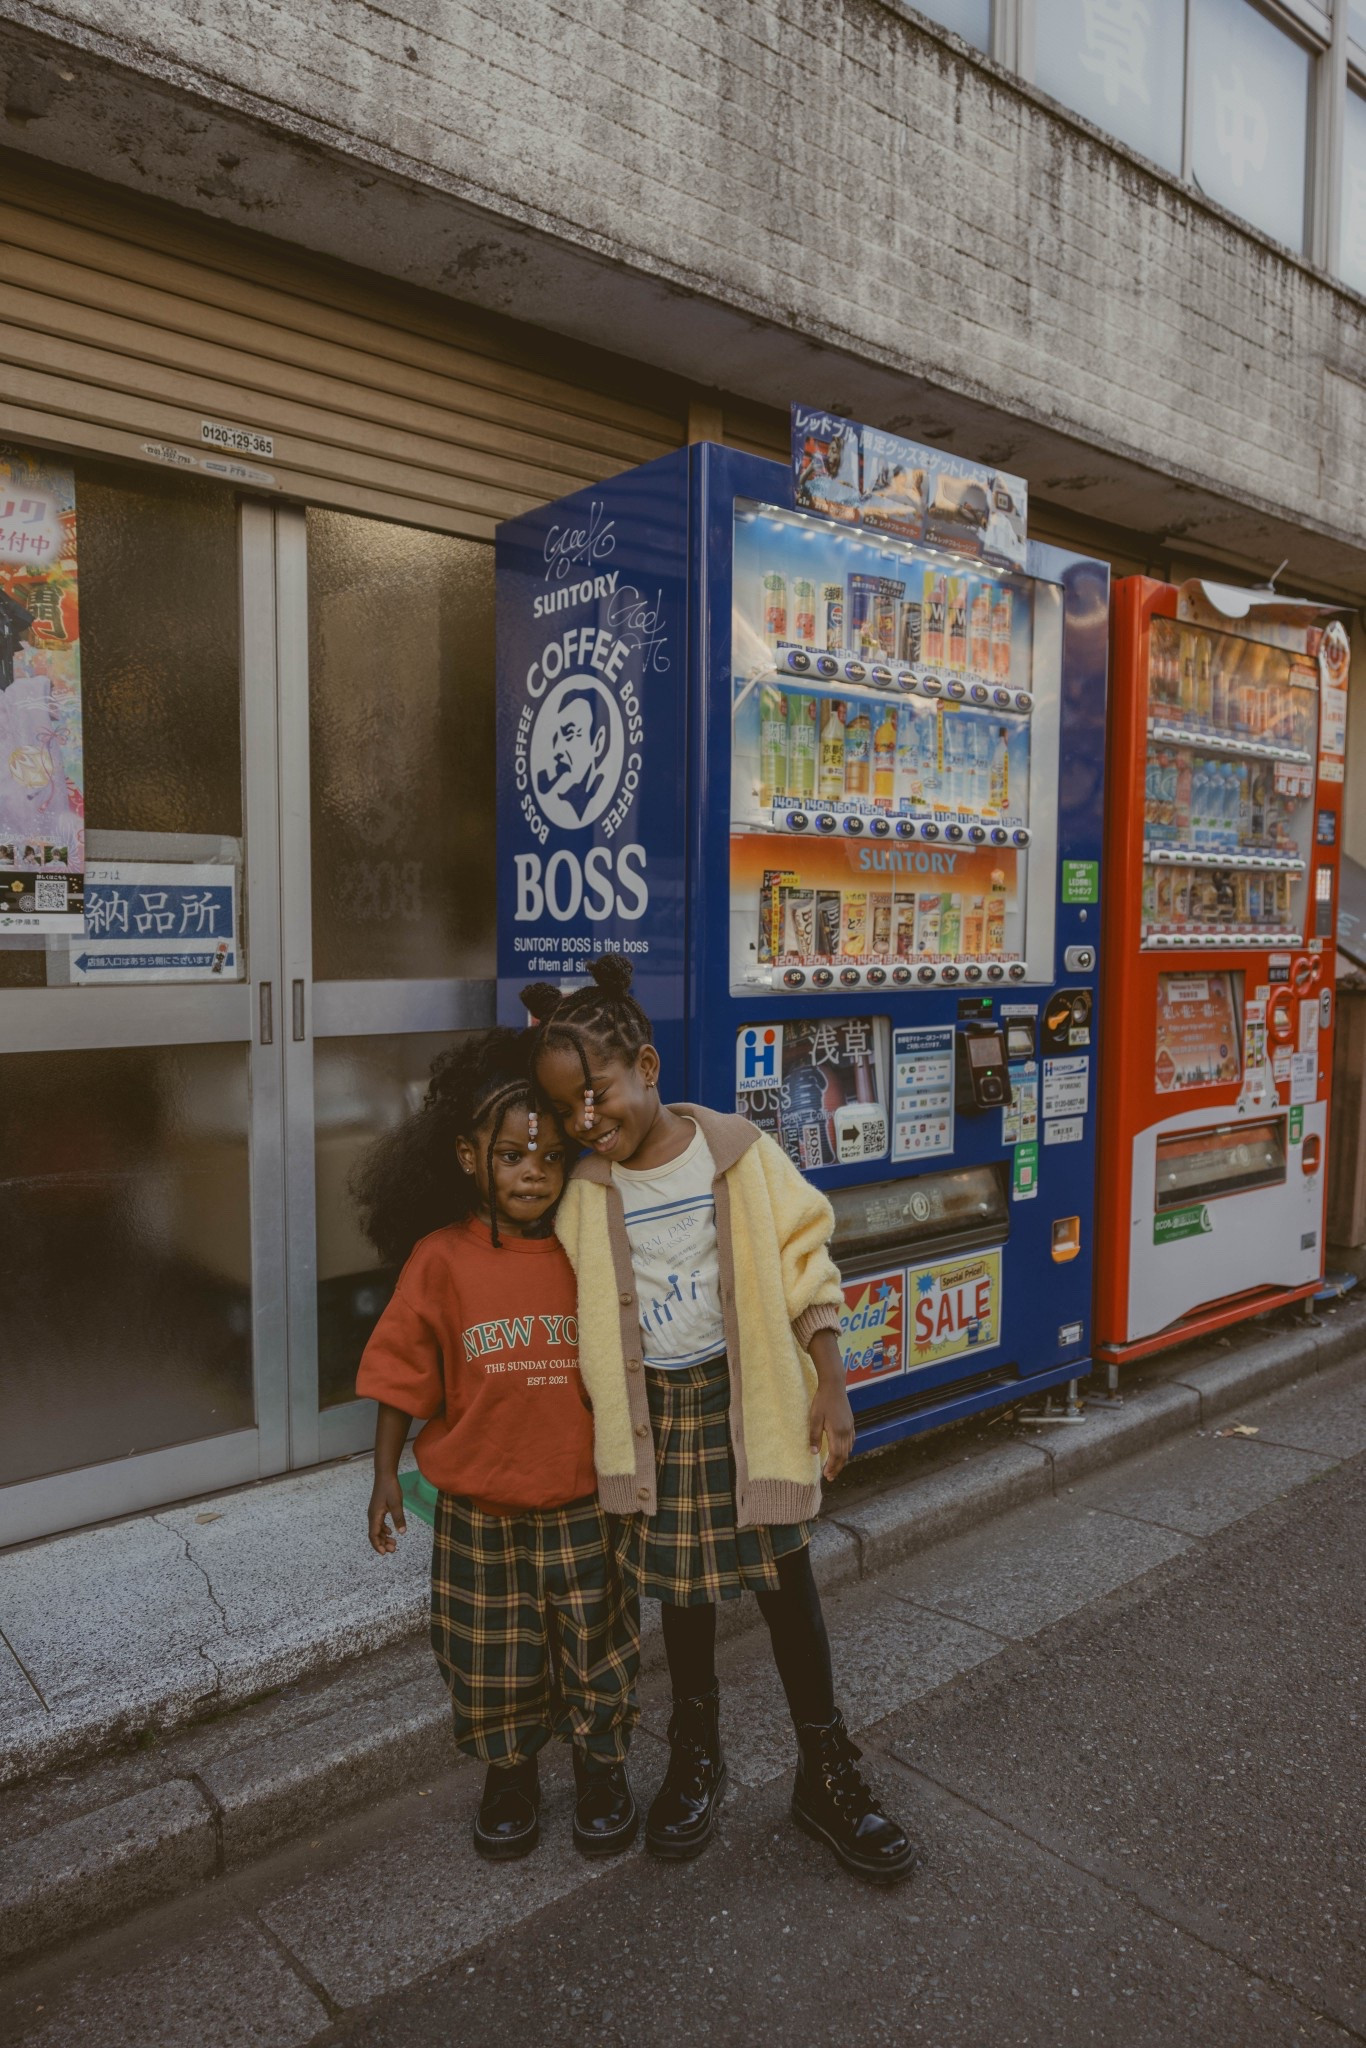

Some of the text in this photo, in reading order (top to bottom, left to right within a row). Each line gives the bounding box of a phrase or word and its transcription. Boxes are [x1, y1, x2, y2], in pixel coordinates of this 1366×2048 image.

[202, 425, 273, 454] 0120-129-365
[795, 409, 858, 442] レッドブル
[532, 570, 620, 619] SUNTORY
[526, 627, 630, 699] COFFEE
[619, 680, 643, 745] BOSS
[515, 704, 534, 791] COFFEE
[601, 753, 642, 839] COFFEE
[520, 794, 550, 845] BOSS
[85, 869, 121, 880] ココは
[859, 847, 958, 873] SUNTORY
[513, 843, 649, 922] BOSS
[86, 890, 221, 934] 納品所
[87, 955, 212, 967] 店舗入口はあちら側にございます
[514, 937, 649, 953] SUNTORY BOSS is the boss
[528, 957, 537, 971] of
[538, 957, 560, 972] them
[562, 958, 573, 972] all
[808, 1019, 873, 1067] 浅草
[735, 1084, 792, 1114] BOSS
[740, 1077, 779, 1089] HACHIYOH
[809, 1128, 820, 1166] BOSS
[942, 1265, 983, 1287] Special Price!
[915, 1280, 991, 1344] SALE
[462, 1315, 535, 1362] NEW
[484, 1363, 506, 1374] THE
[507, 1360, 549, 1372] SUNDAY
[527, 1375, 569, 1386] EST. 2021
